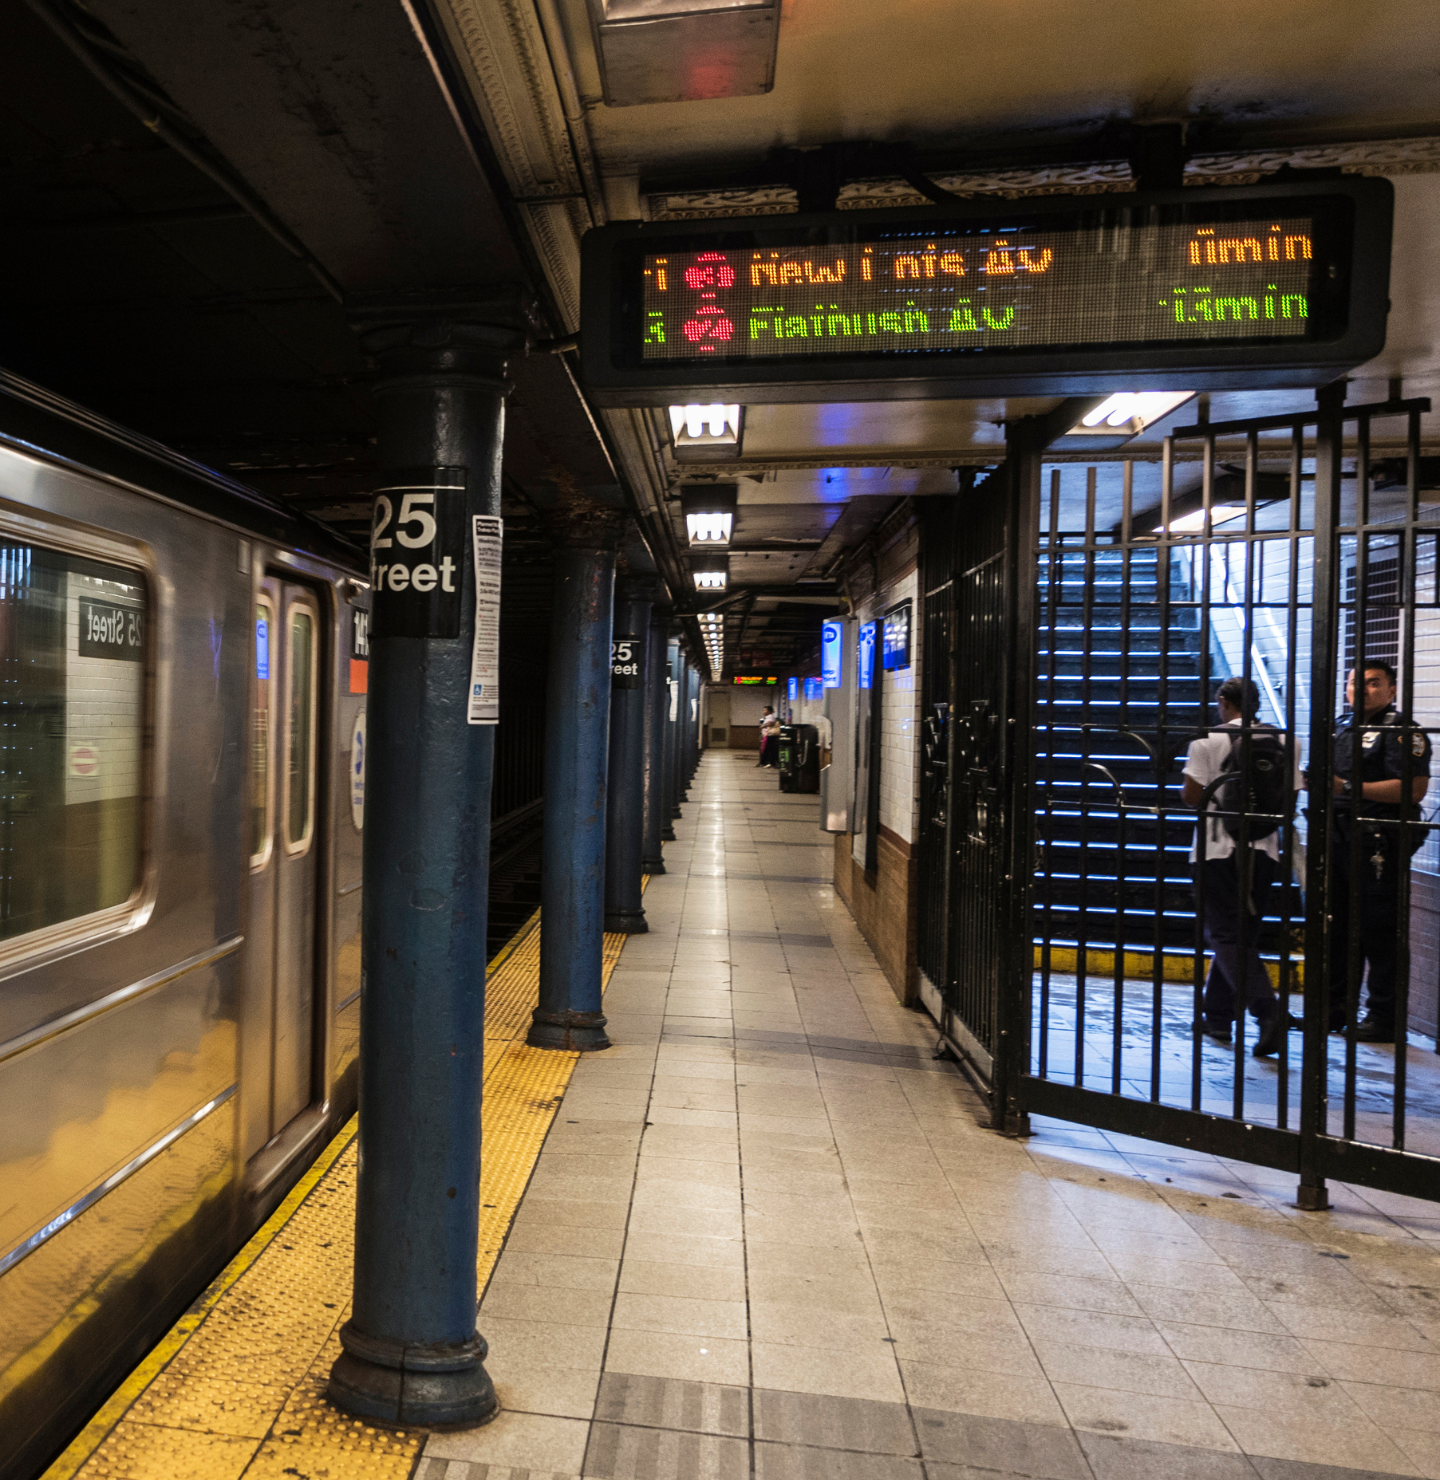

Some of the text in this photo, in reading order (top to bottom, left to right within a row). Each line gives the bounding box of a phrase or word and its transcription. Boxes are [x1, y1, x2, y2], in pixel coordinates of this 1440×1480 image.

[986, 239, 1052, 275] Av
[949, 298, 1015, 331] Av
[372, 493, 437, 549] 25
[612, 642, 632, 661] 25
